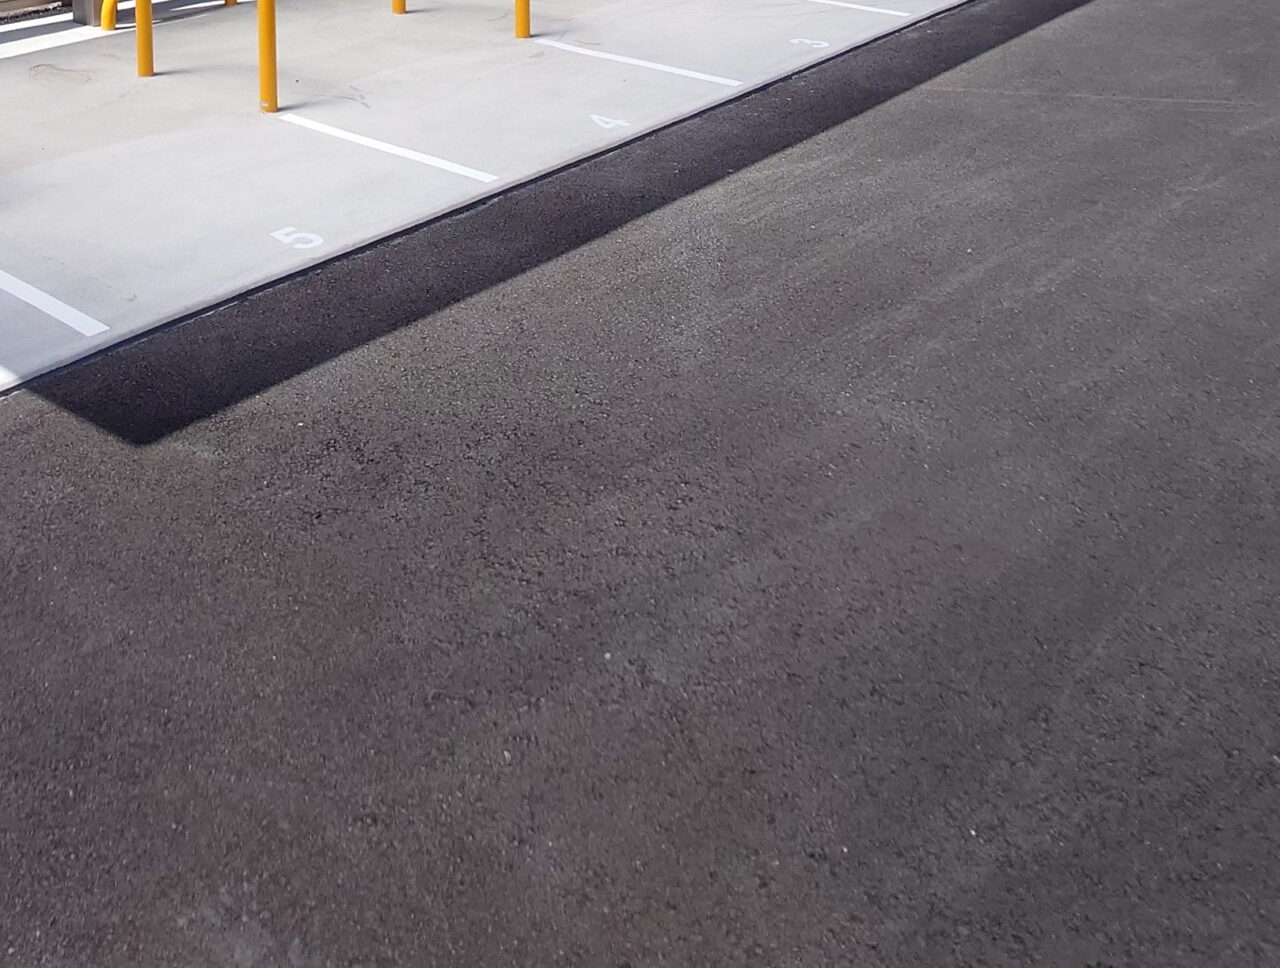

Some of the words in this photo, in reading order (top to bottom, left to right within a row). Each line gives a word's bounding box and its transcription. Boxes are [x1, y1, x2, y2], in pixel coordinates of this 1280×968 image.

[788, 37, 831, 49] 3
[588, 113, 632, 129] 4
[270, 225, 325, 250] 5
